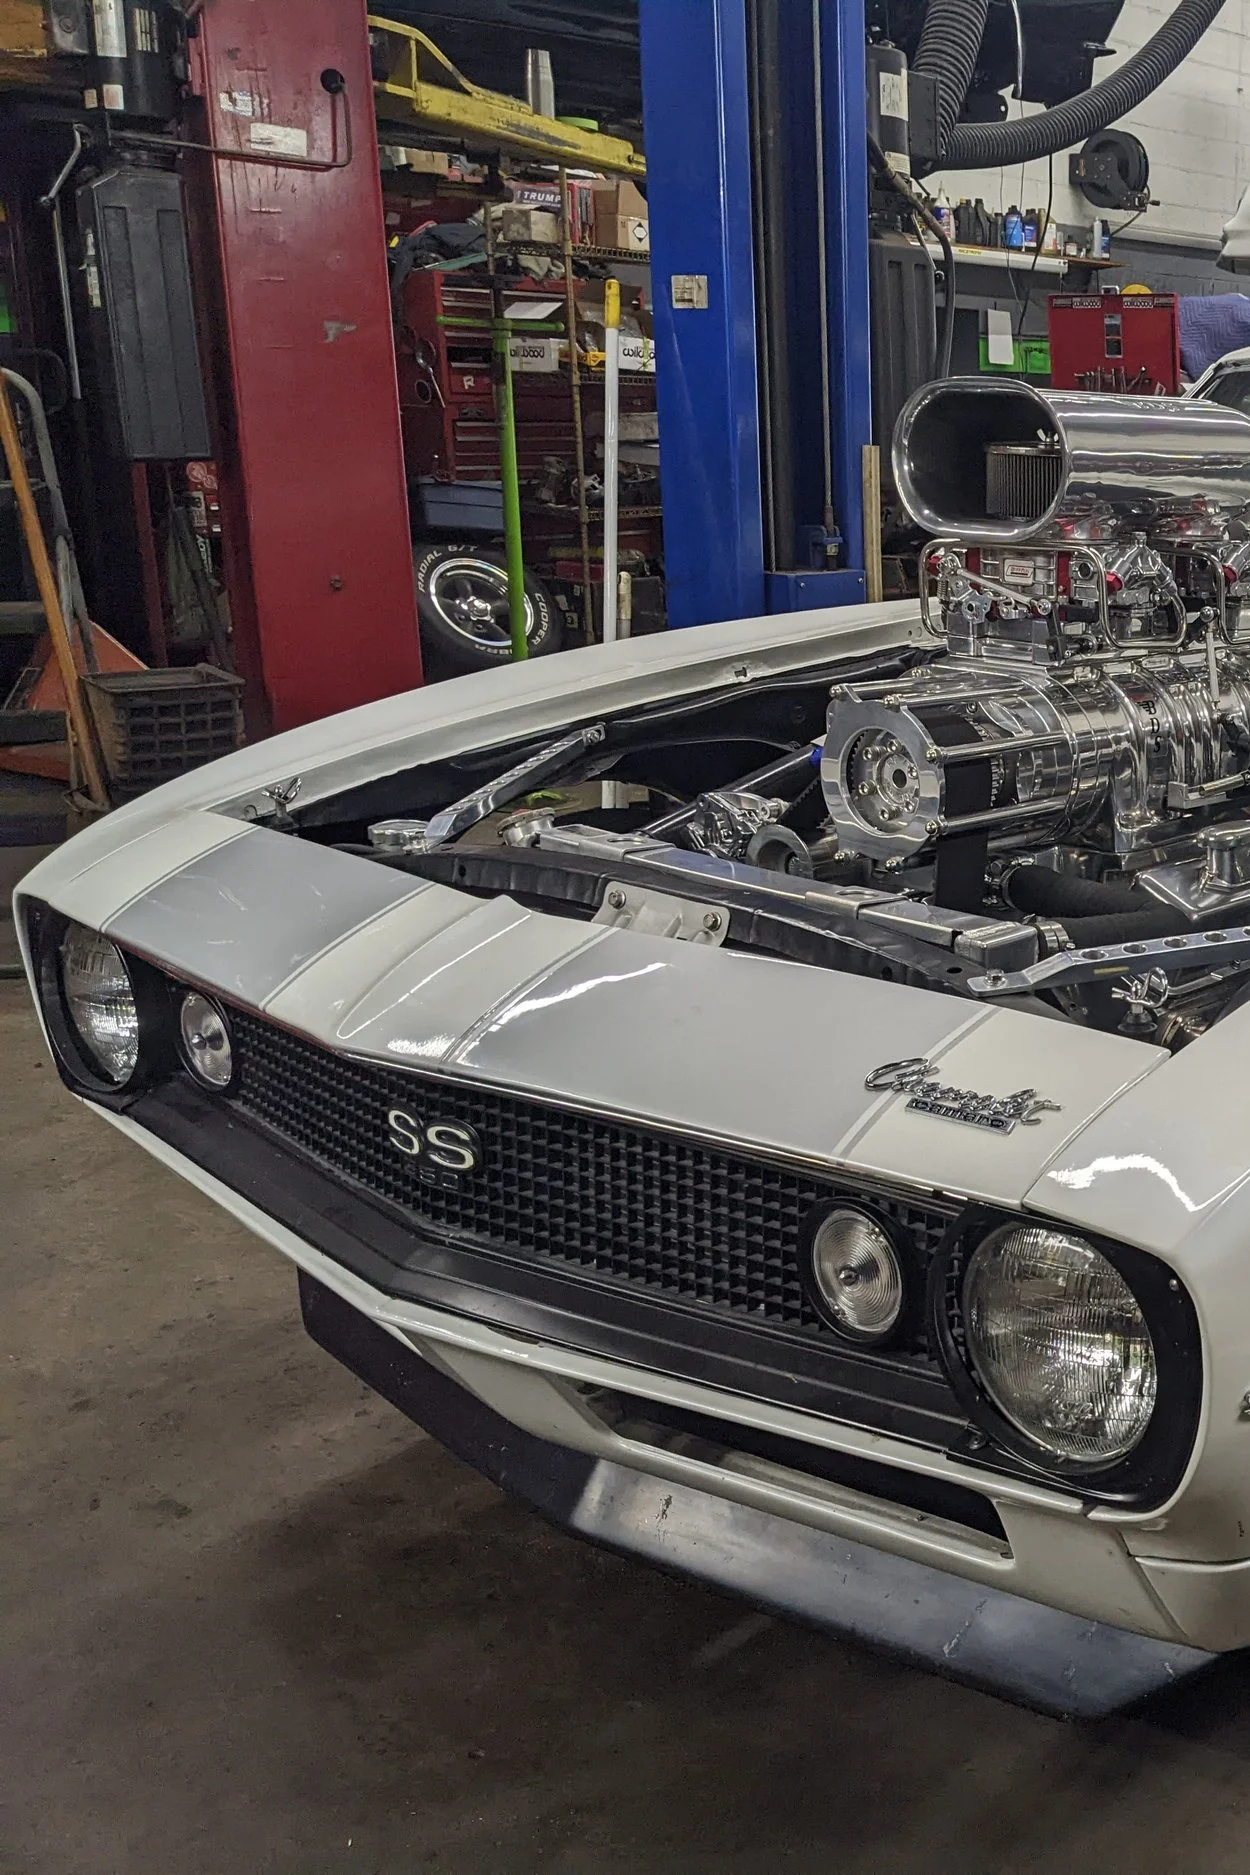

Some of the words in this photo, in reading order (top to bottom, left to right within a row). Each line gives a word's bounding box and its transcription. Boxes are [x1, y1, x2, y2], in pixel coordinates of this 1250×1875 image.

[417, 550, 442, 593] RADIAL
[532, 593, 549, 645] COOPER
[388, 1109, 474, 1169] SS
